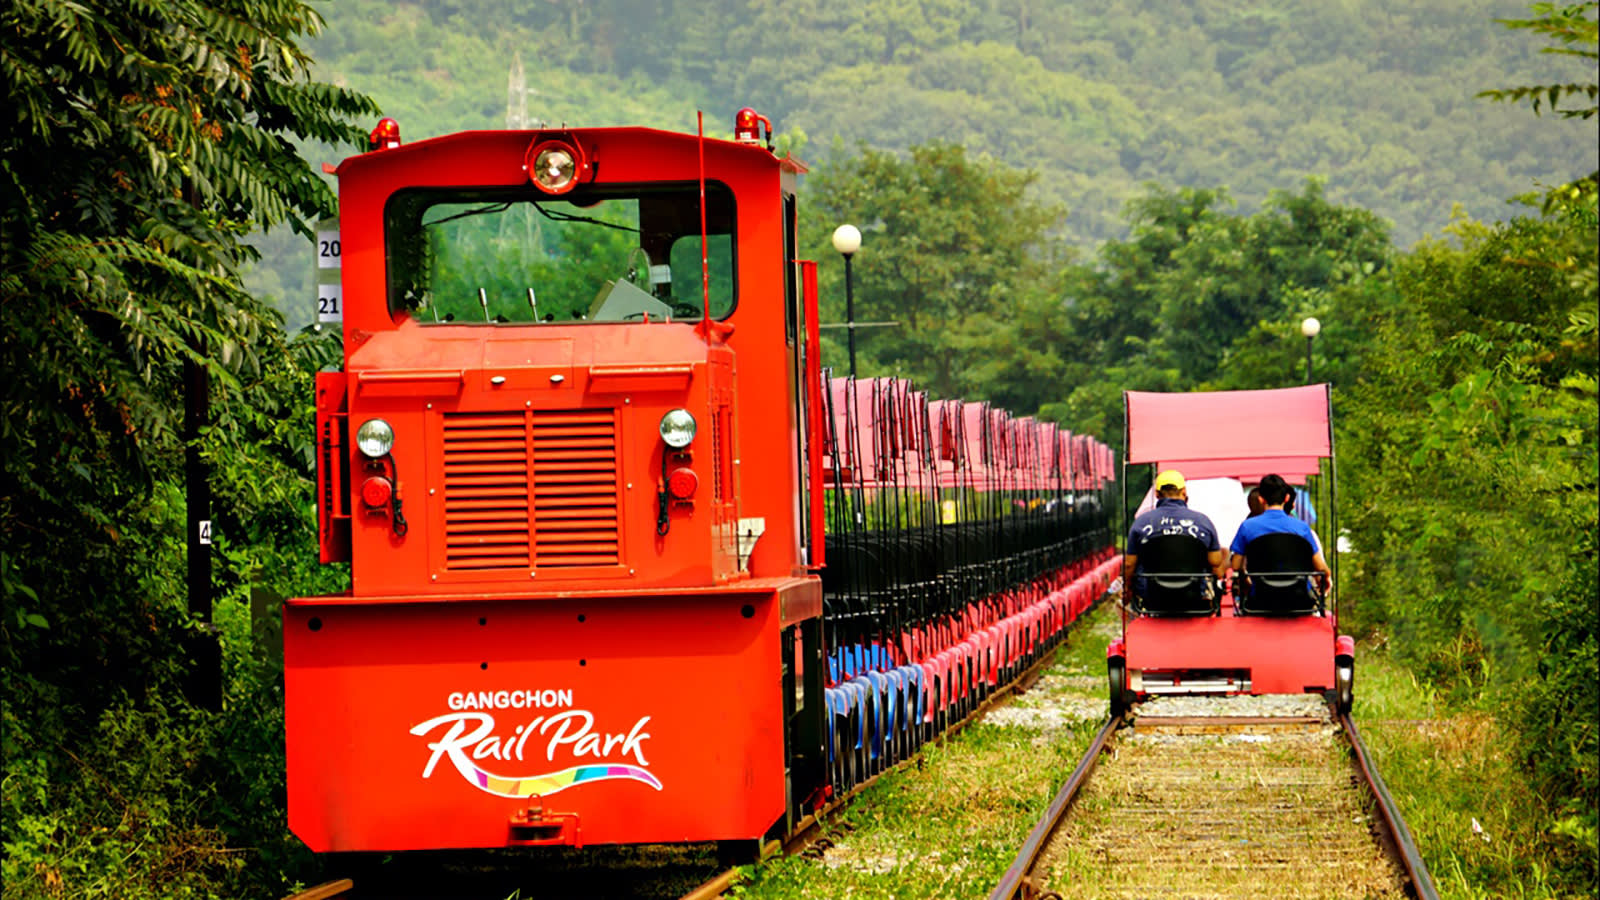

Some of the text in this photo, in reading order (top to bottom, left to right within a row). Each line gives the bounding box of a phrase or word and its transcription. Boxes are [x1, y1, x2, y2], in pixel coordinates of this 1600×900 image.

[320, 240, 341, 258] 20
[318, 297, 339, 315] 21
[448, 689, 573, 710] GANGCHON
[409, 710, 651, 778] Rail Park
